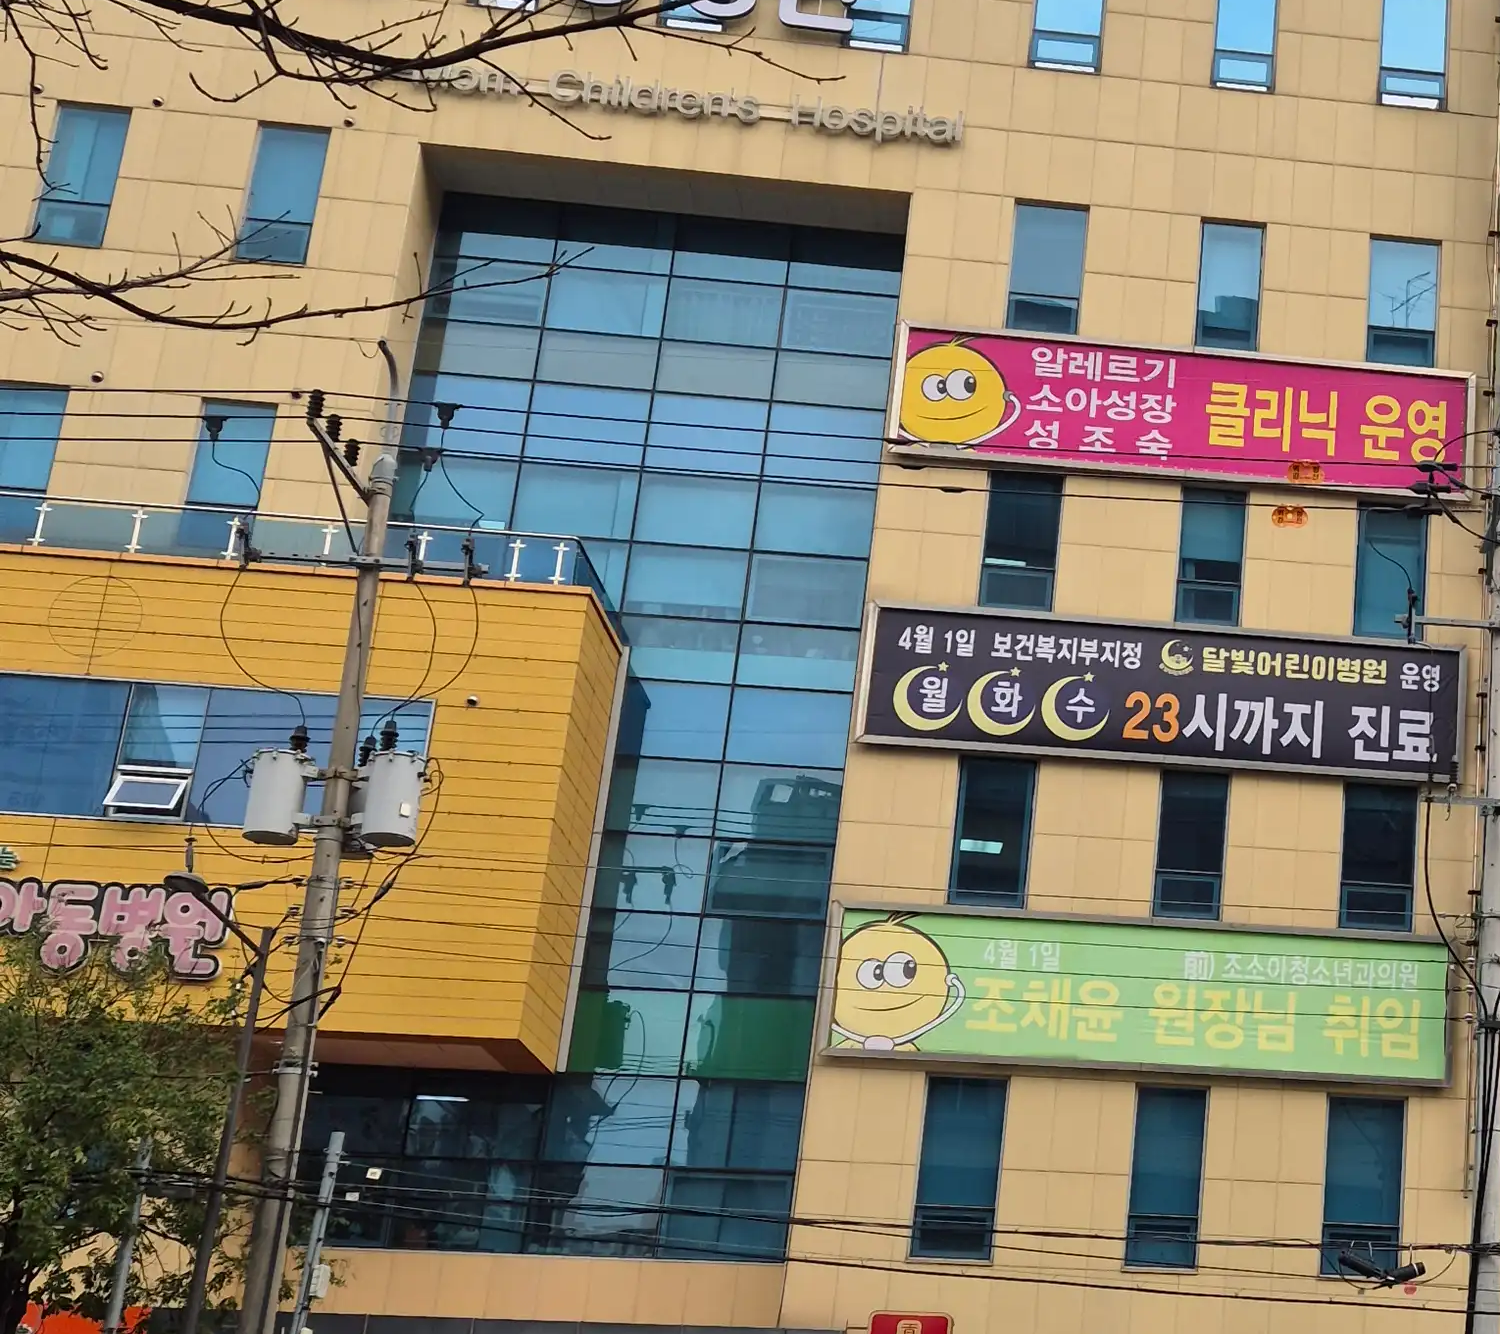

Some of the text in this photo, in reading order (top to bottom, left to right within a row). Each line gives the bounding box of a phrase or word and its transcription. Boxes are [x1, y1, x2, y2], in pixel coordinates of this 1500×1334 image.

[549, 68, 761, 125] Children's
[791, 94, 966, 146] Hospital
[1031, 346, 1177, 389] 알레르기
[1025, 388, 1177, 424] 소아성장
[1205, 381, 1448, 465] 클리닉 운영
[898, 626, 935, 655] 4월
[944, 629, 976, 658] 1일
[990, 631, 1143, 670] 보건복지부지정
[1202, 645, 1388, 686] 달빛어린이병원
[1398, 660, 1441, 692] 운영
[919, 675, 1438, 763] 월 화 수 23시까지 진료
[984, 940, 1021, 969] 4월
[1028, 942, 1061, 971] 1일
[965, 974, 1421, 1062] 조채윤 원장님 취임
